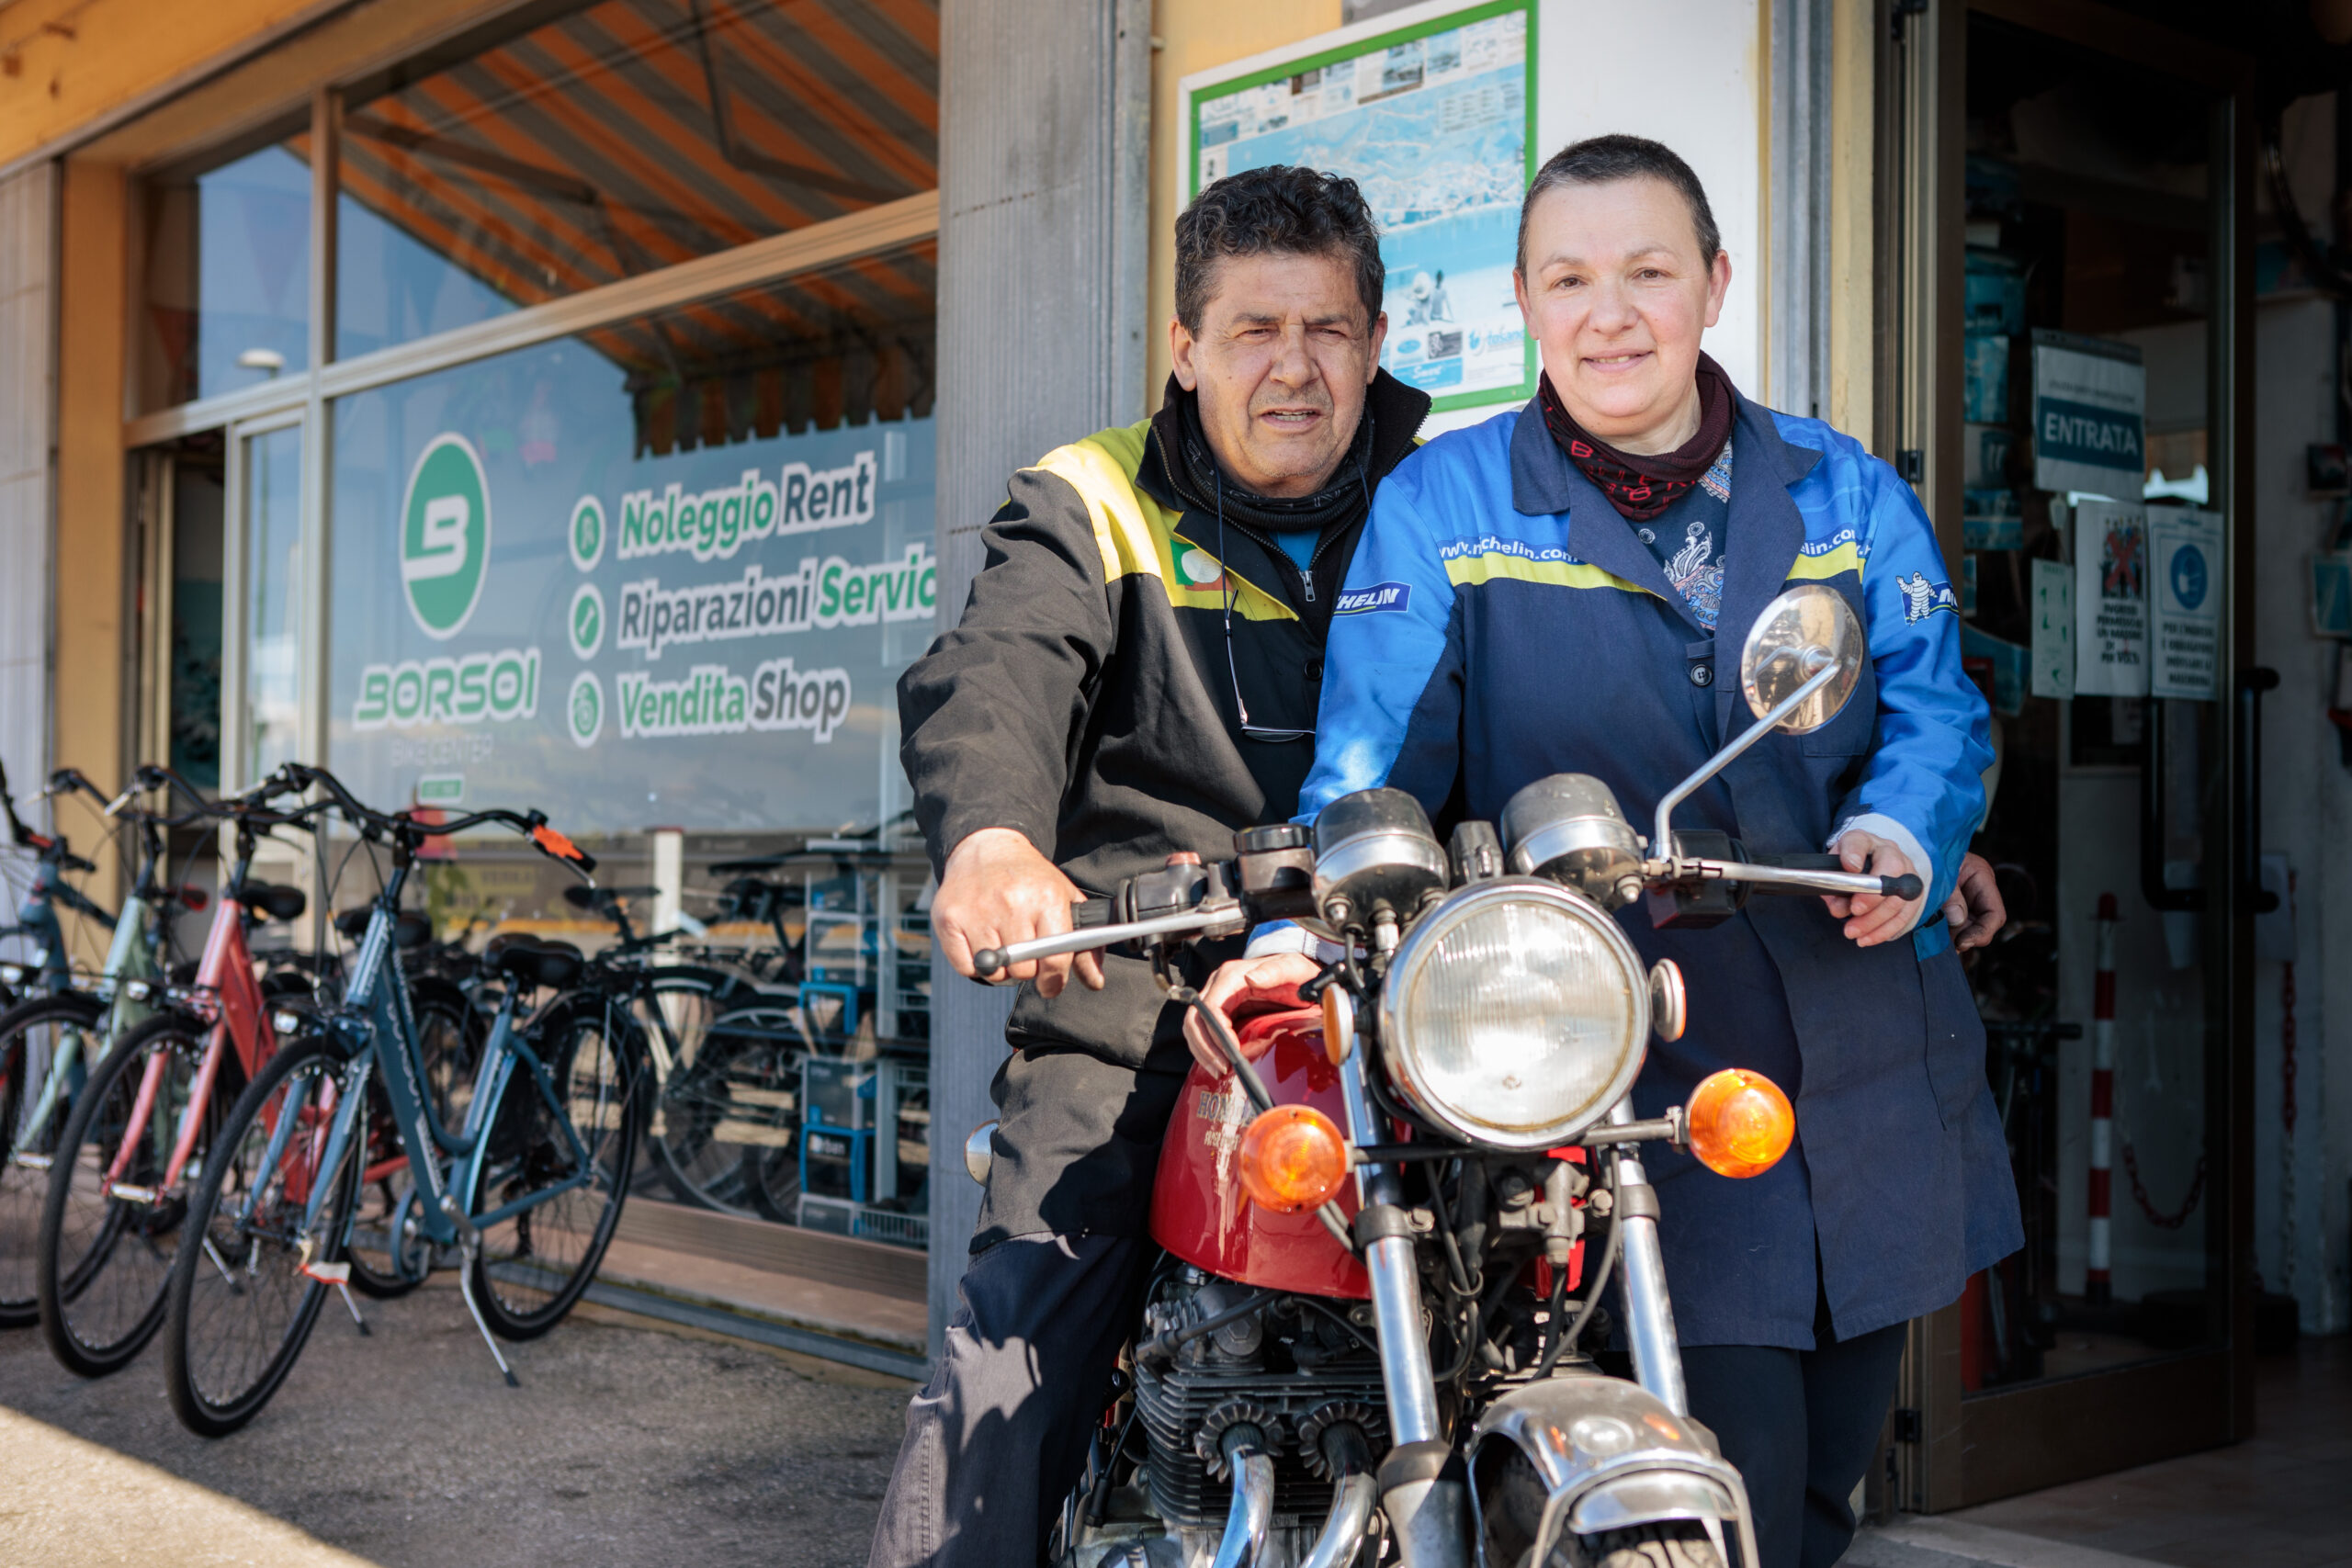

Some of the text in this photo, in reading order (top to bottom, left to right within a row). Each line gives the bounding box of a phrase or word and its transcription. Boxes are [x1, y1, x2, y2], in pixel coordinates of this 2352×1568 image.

[2045, 412, 2139, 457] ENTRATA
[622, 463, 872, 557] Noleggio Rent
[622, 570, 810, 654] Riparazioni
[1336, 588, 1401, 610] HELIN
[356, 651, 539, 726] BORSOI
[620, 662, 847, 737] Vendita Shop
